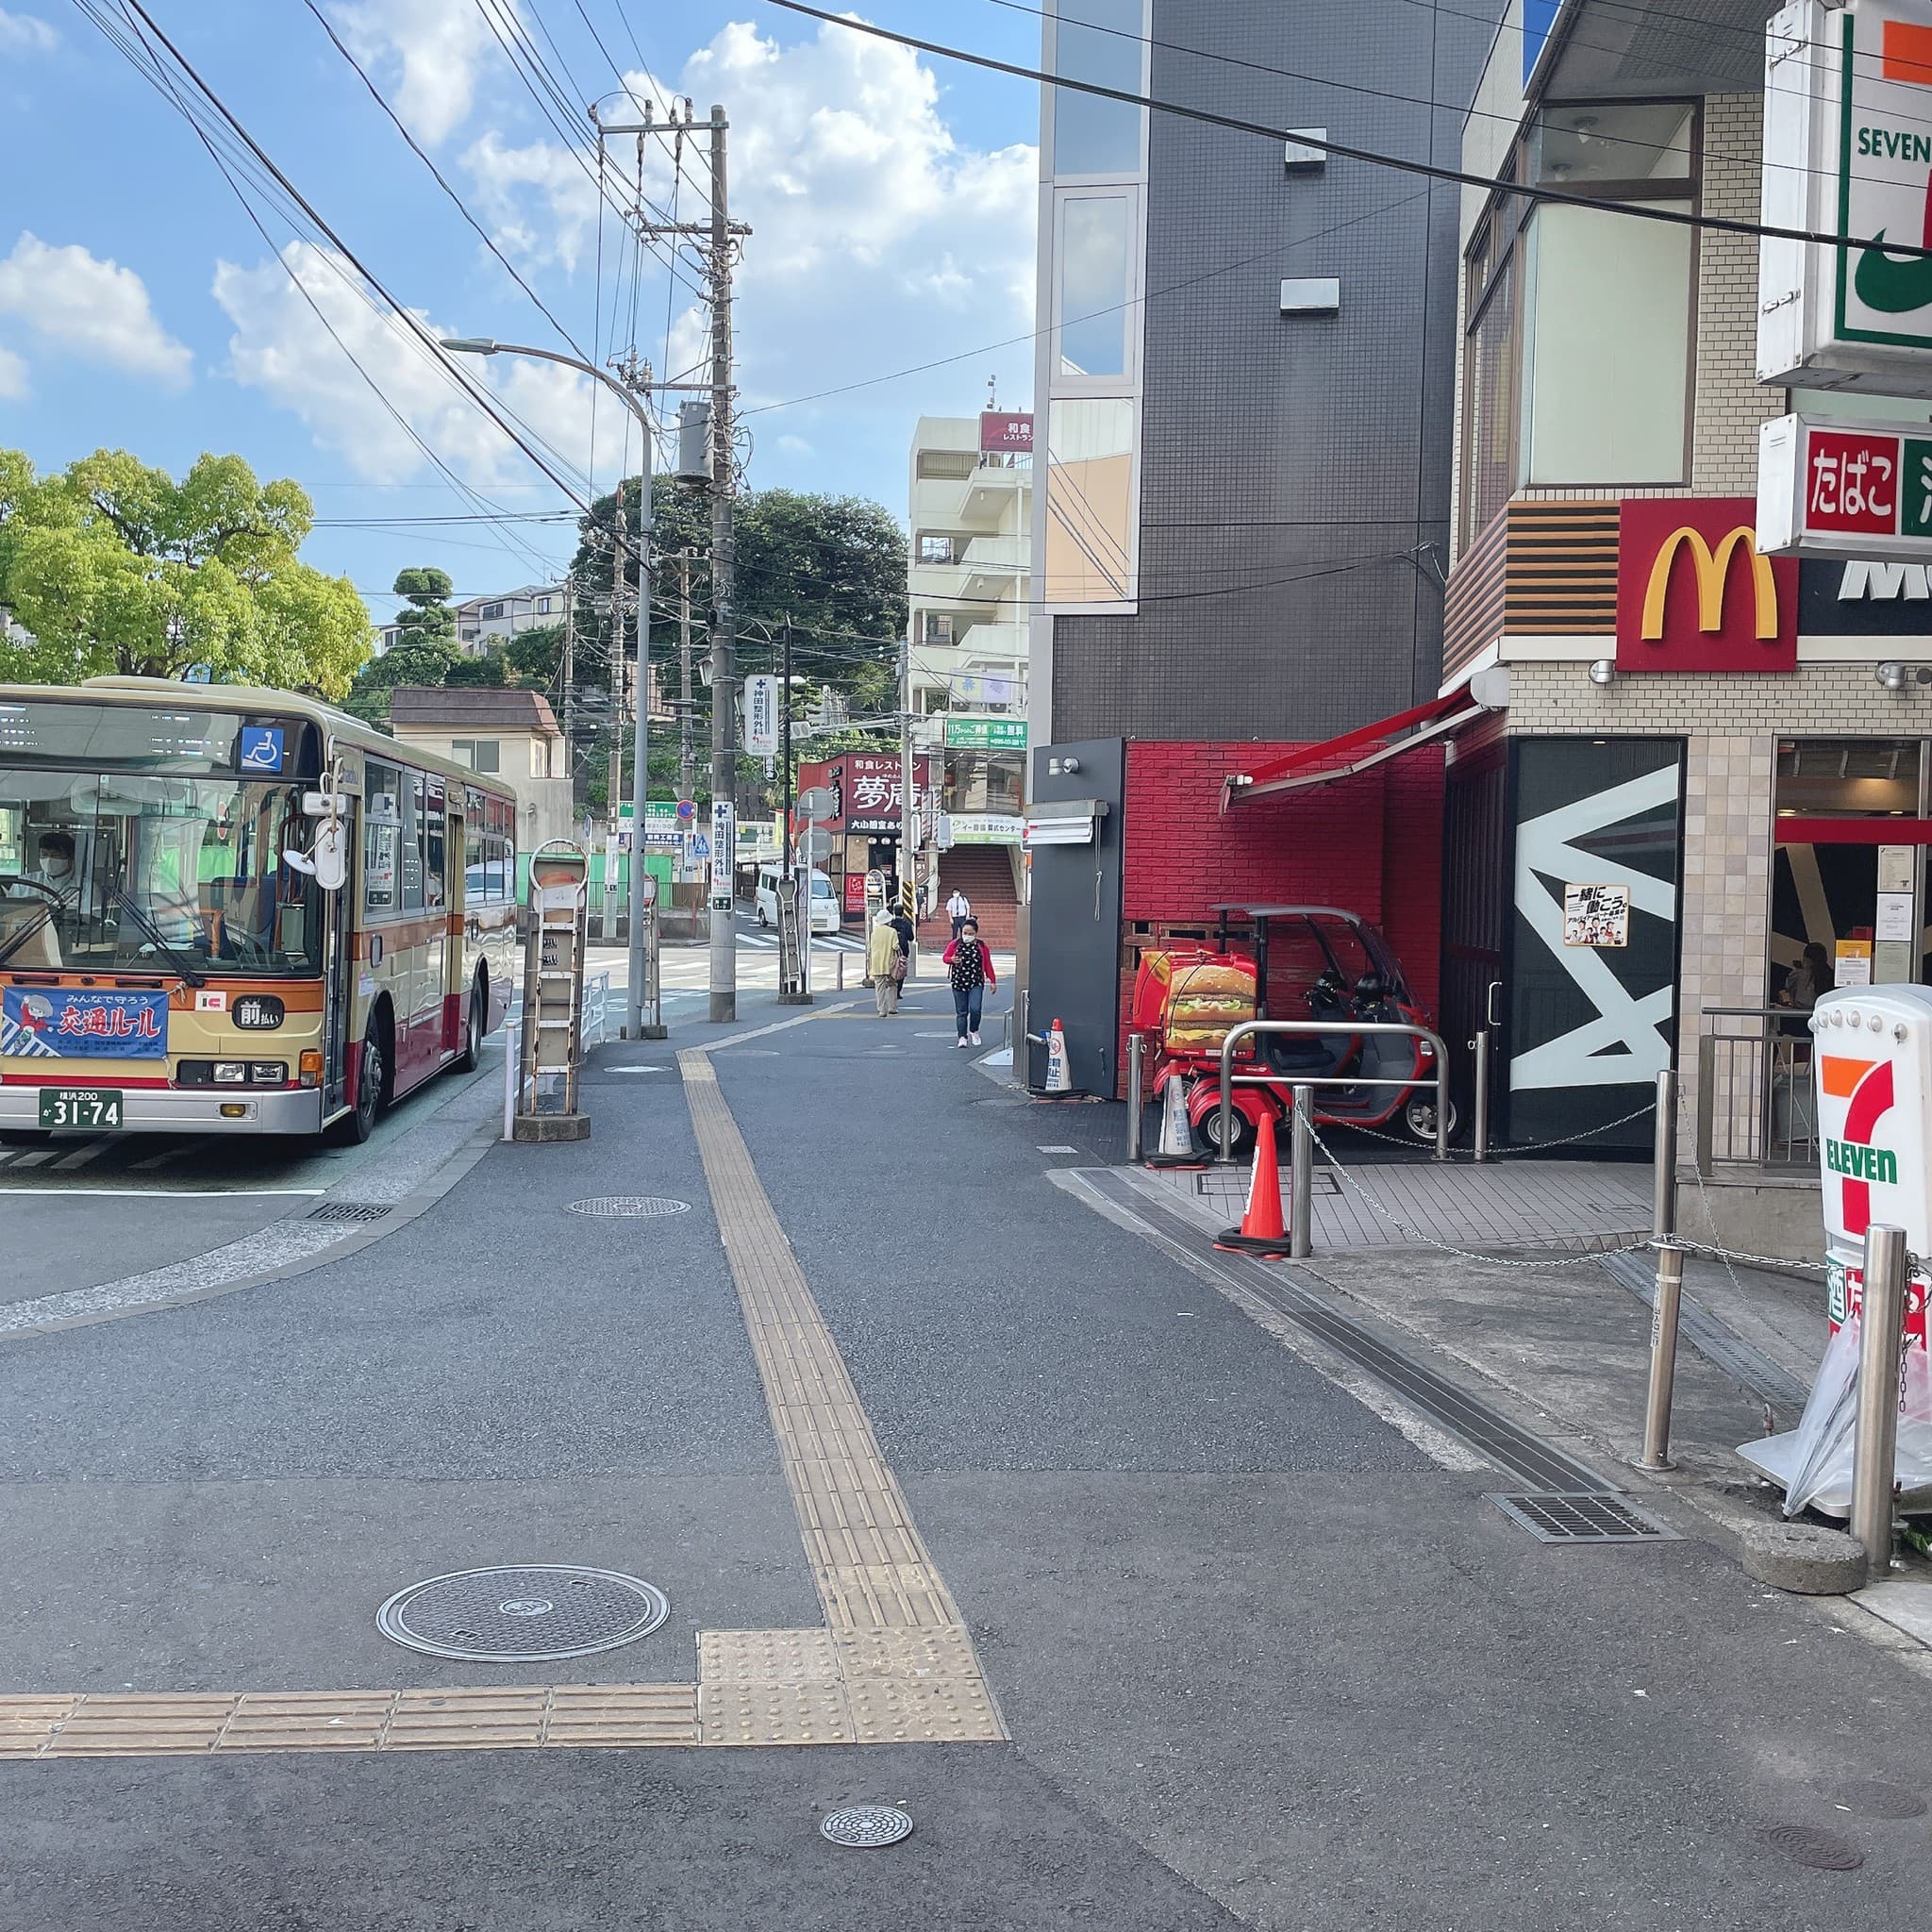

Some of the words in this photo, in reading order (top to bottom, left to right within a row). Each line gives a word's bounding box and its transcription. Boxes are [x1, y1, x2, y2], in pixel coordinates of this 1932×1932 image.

[1857, 126, 1931, 163] SEVEN
[1003, 433, 1034, 441] レストラン
[1008, 422, 1030, 434] 和食
[1811, 448, 1891, 516] たばこ
[1838, 560, 1932, 601] M
[855, 759, 921, 771] 和食レストン
[714, 822, 724, 875] 神田整形外科
[1567, 887, 1606, 902] 一緒に
[66, 994, 149, 1005] みんなで守ろう
[58, 1005, 161, 1038] 交通ルール
[240, 1001, 279, 1025] 前払い
[54, 1101, 118, 1124] 31-74
